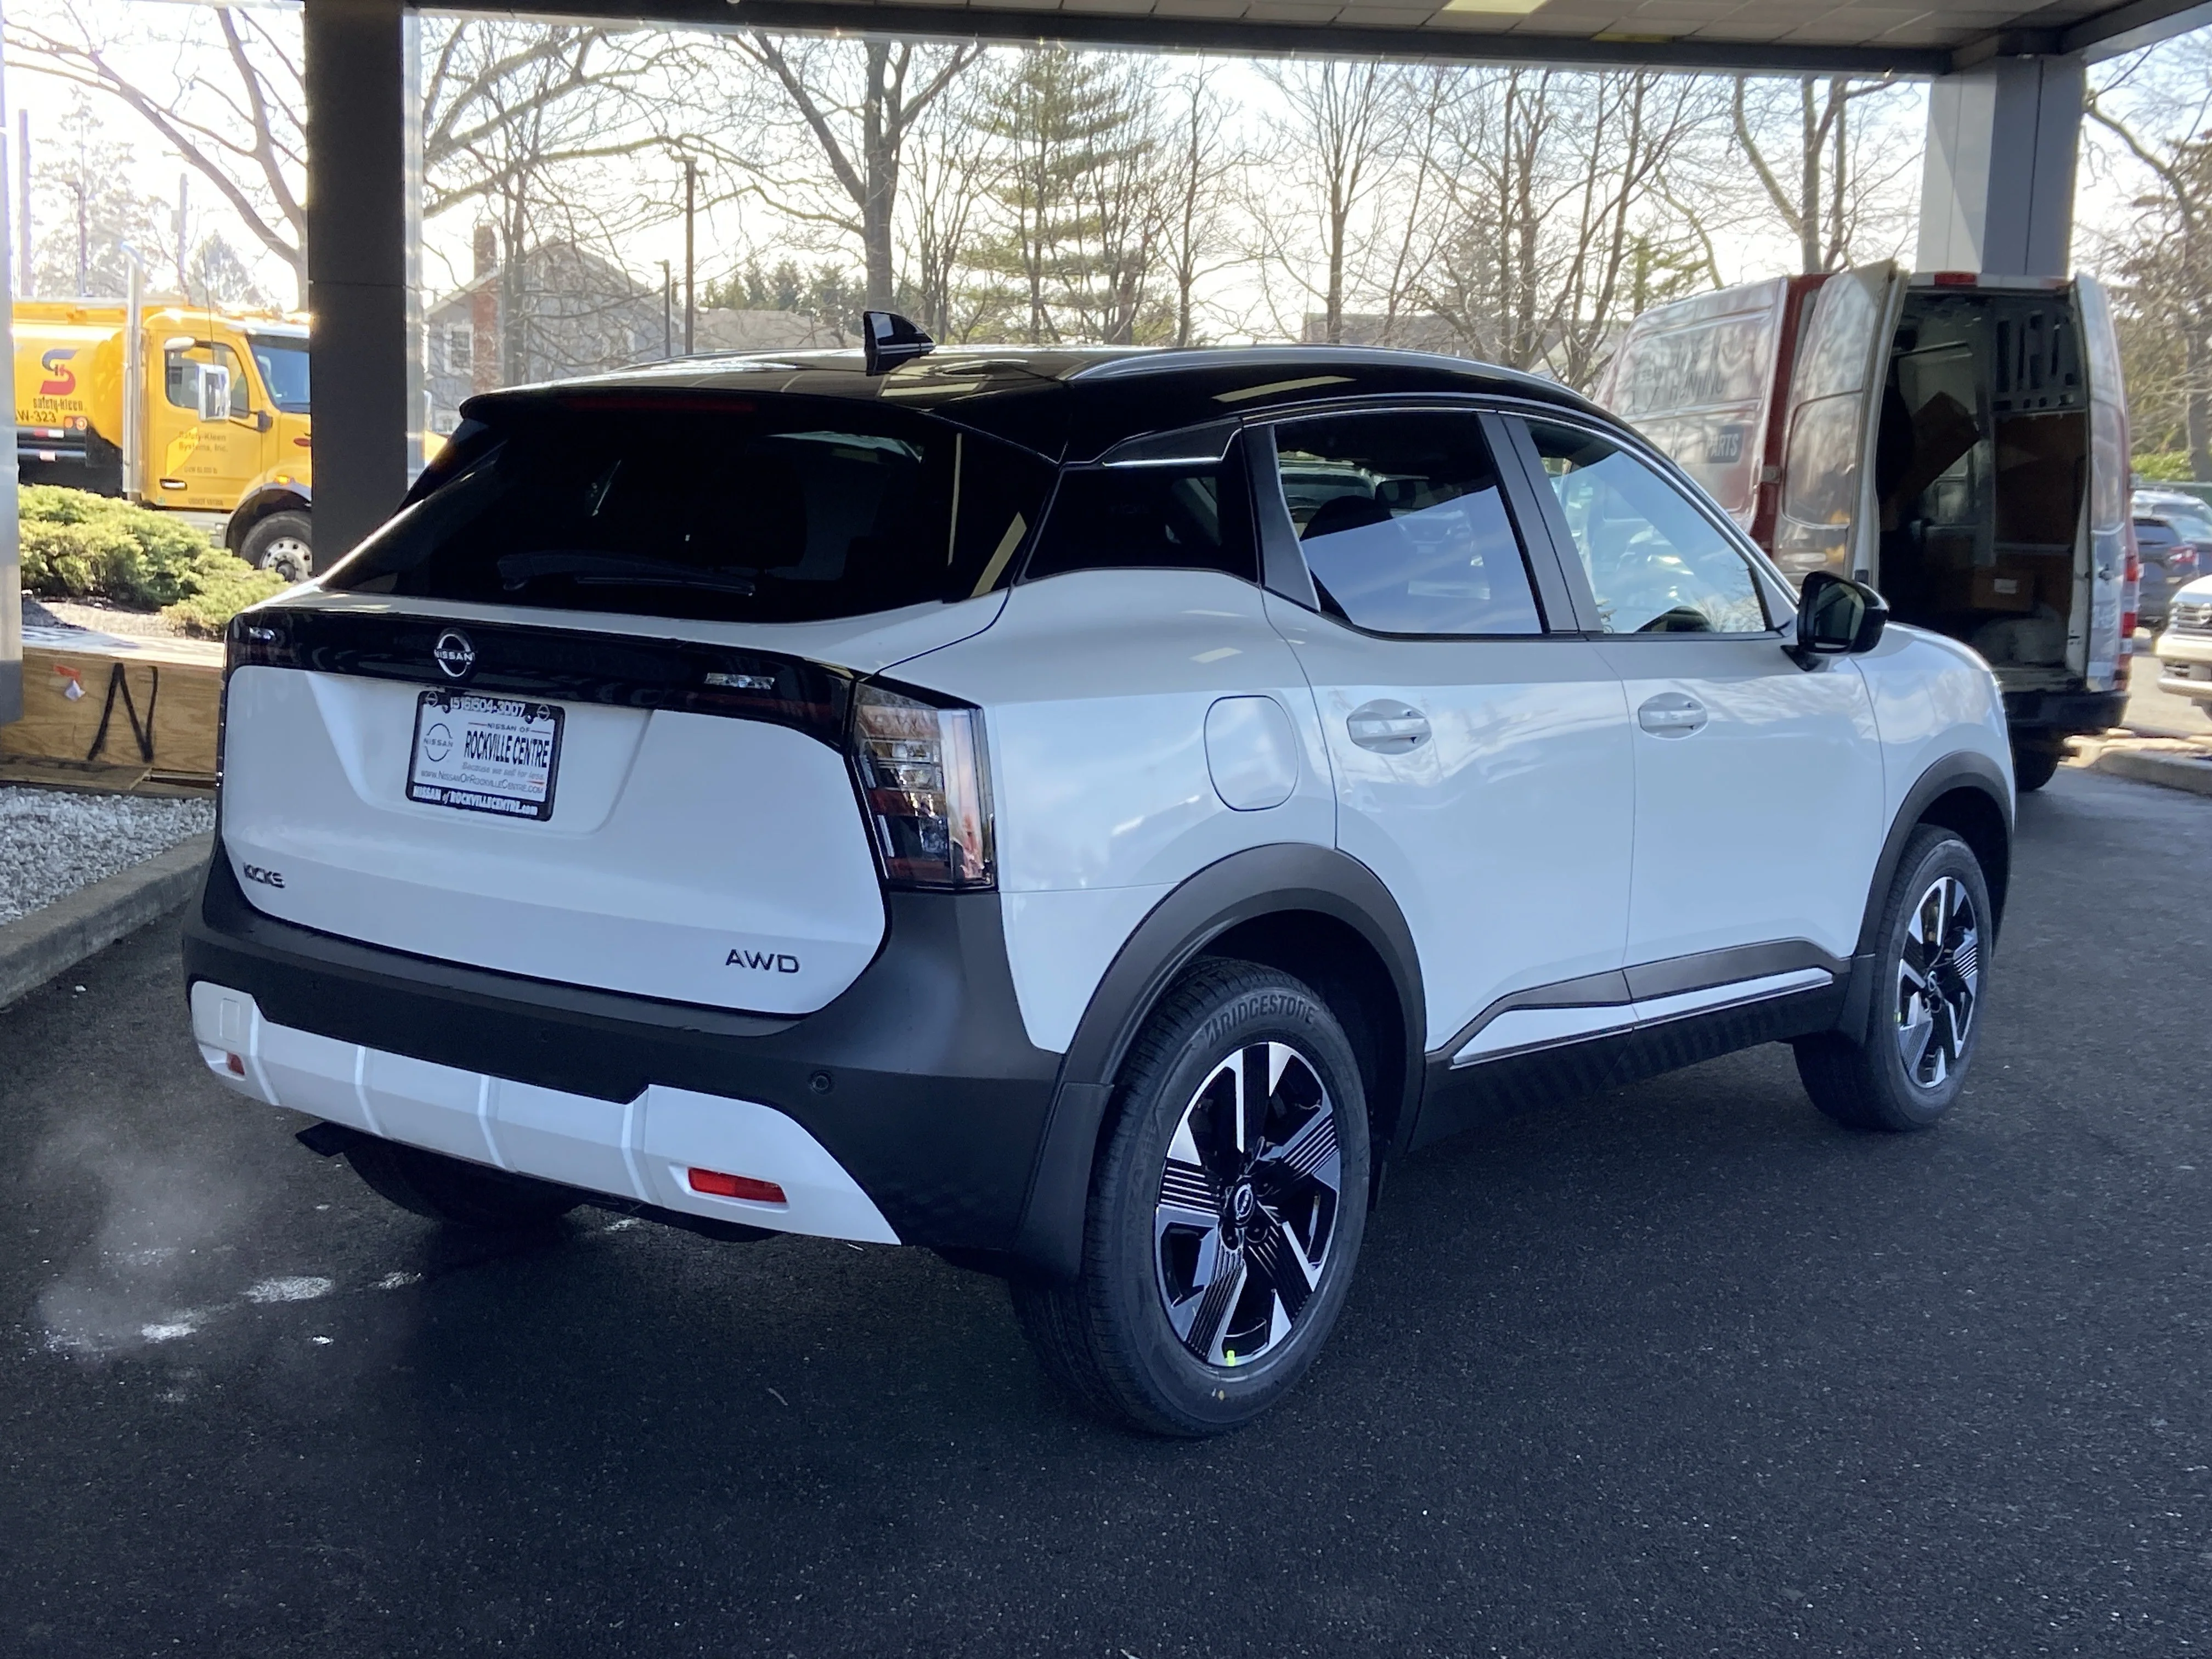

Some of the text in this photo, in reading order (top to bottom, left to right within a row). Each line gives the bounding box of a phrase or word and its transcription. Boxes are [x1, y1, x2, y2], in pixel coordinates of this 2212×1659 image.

[15, 409, 57, 423] W-323
[487, 723, 516, 732] NISSAN
[424, 737, 454, 748] NISSAN
[464, 730, 550, 768] ROCKVILLE CENTRE
[242, 861, 286, 889] KICKS
[725, 949, 800, 973] AWD
[1204, 994, 1316, 1049] BRIDGESTONE
